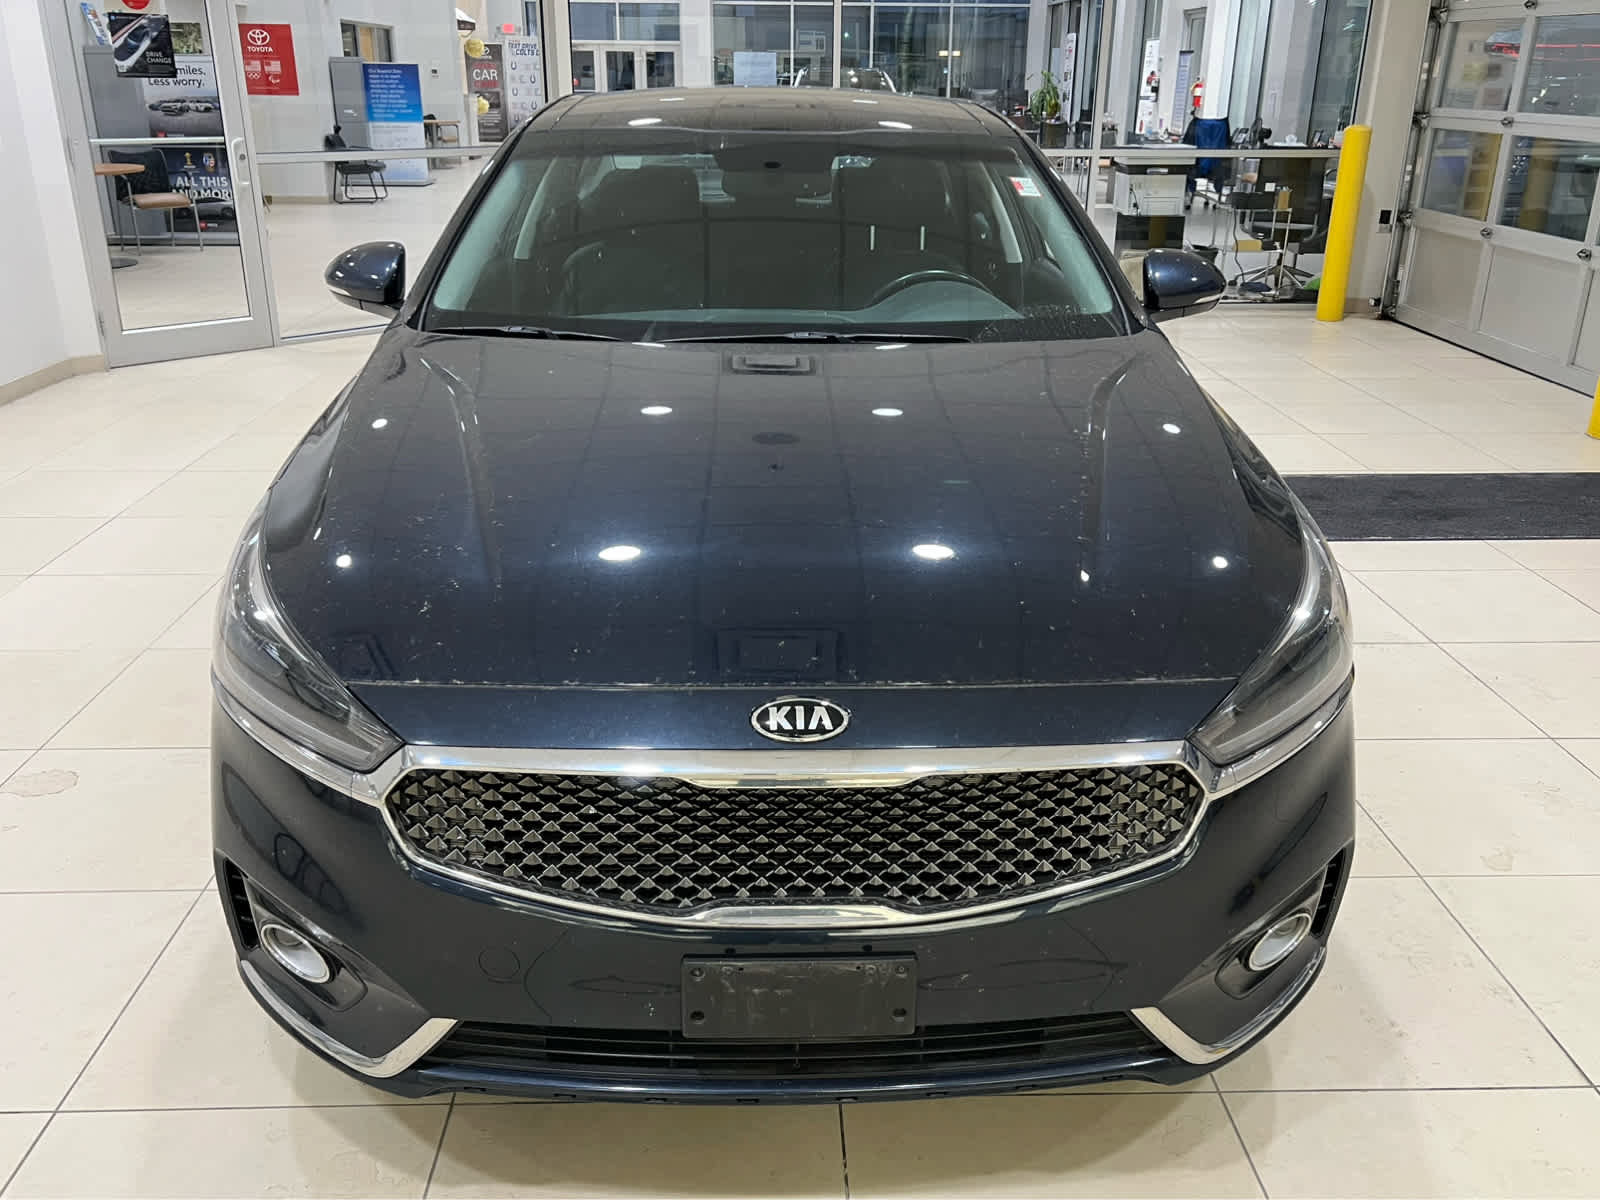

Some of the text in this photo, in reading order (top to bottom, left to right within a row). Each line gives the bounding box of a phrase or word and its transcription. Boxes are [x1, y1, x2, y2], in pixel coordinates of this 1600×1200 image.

[472, 69, 498, 81] CAR
[148, 77, 170, 86] Less
[175, 176, 228, 188] ALL THIS
[767, 704, 834, 731] KIA
